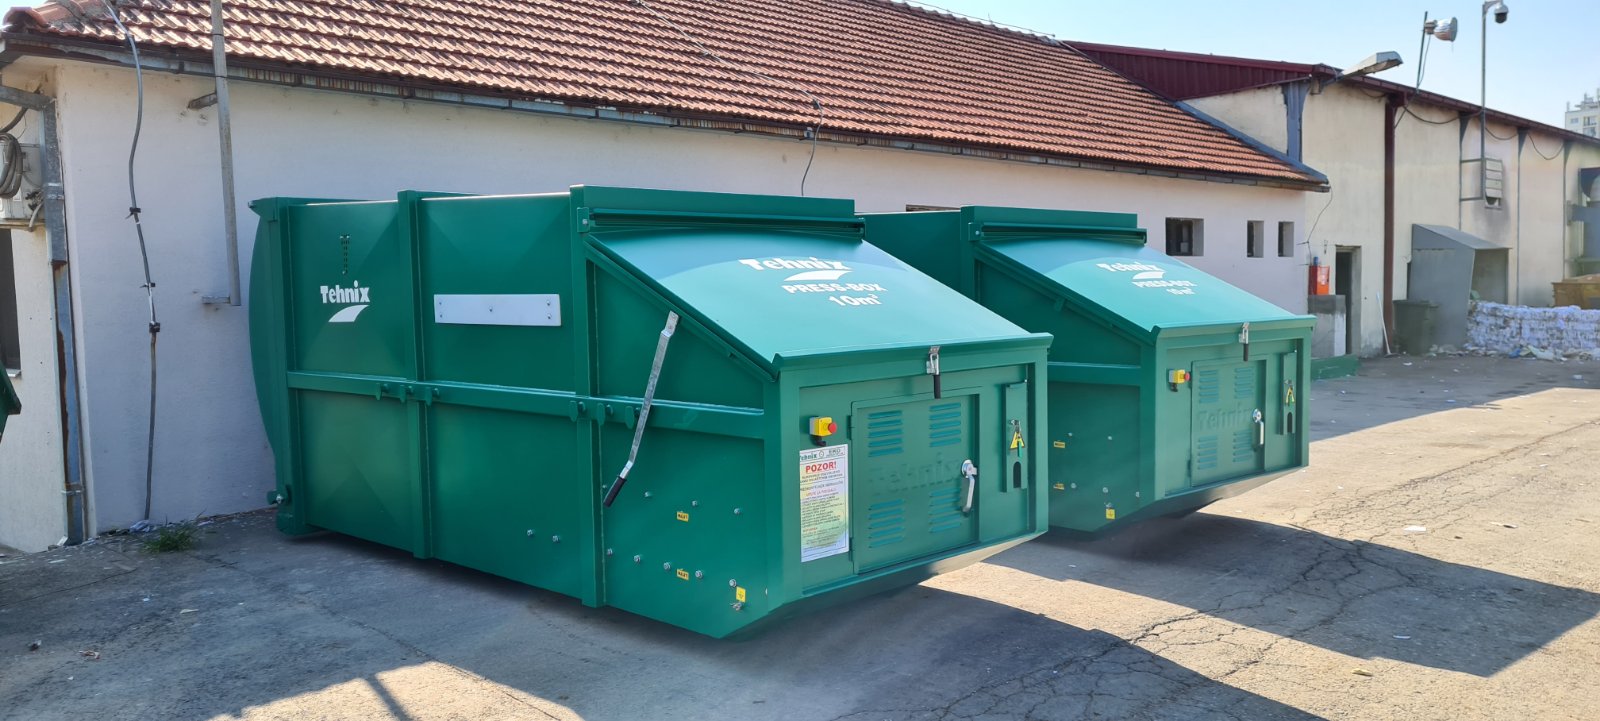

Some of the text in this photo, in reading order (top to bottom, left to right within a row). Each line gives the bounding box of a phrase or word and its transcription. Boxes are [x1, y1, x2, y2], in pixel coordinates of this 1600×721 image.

[738, 257, 852, 270] Tehnix
[320, 280, 370, 304] Tehnix
[782, 283, 887, 294] PRESS-BOX
[805, 461, 837, 473] POZOR!
